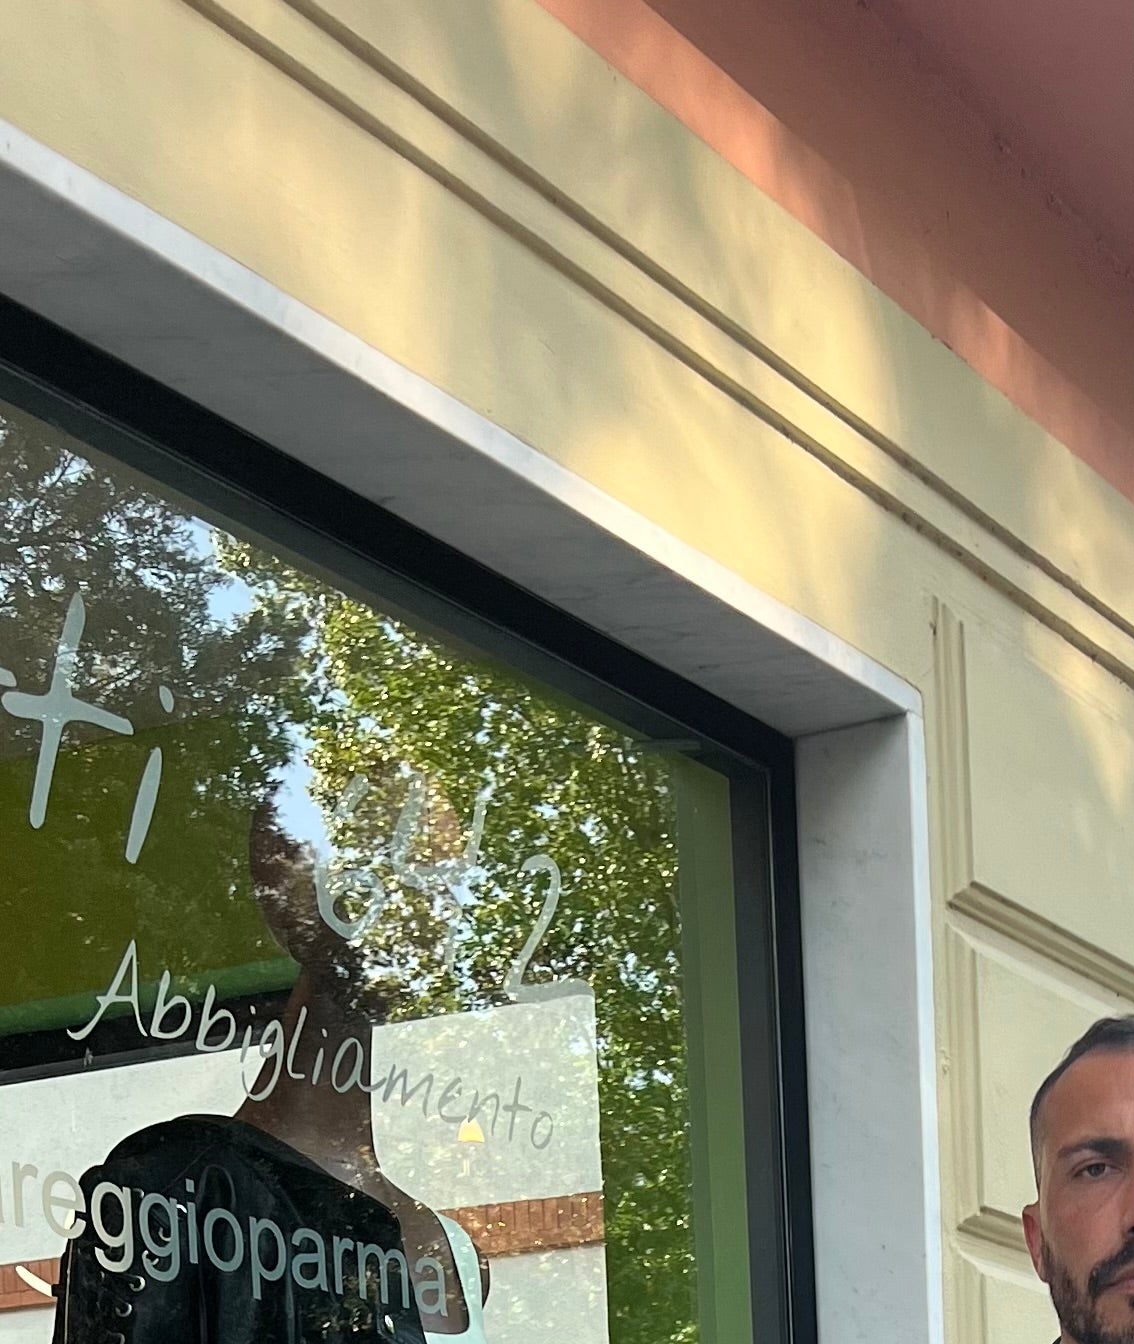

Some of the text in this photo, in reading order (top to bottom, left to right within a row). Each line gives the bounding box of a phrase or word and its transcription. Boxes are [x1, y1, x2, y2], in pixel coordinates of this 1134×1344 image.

[0, 591, 175, 865] ti
[66, 938, 555, 1150] Abbigliamento
[0, 1160, 450, 1318] reggioparma
